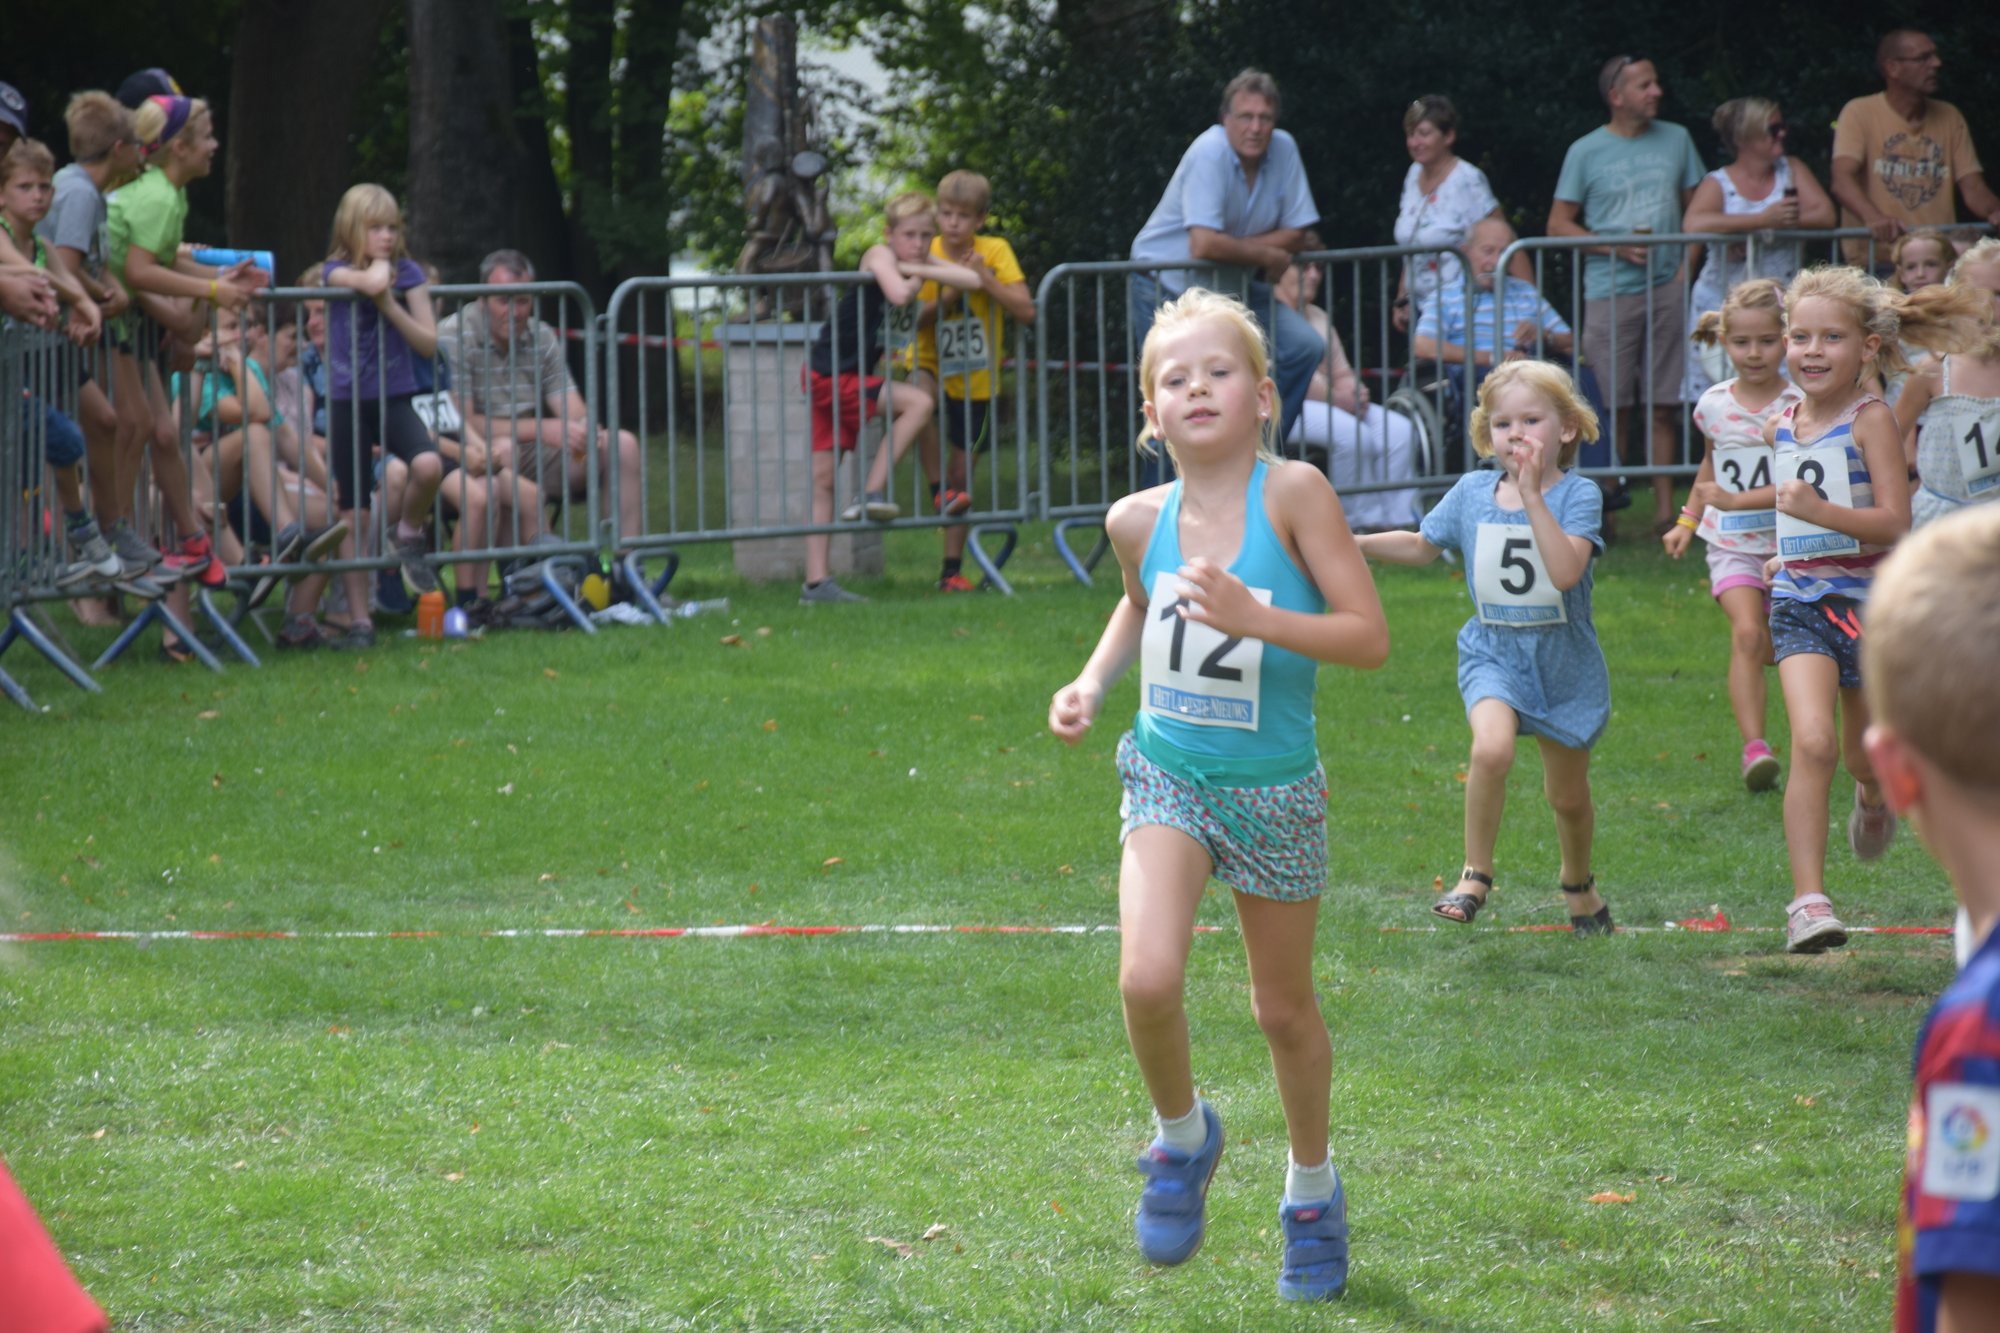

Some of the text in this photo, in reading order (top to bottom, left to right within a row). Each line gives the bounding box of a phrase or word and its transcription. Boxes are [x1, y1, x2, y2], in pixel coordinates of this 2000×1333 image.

[942, 323, 984, 358] 255
[1963, 421, 2000, 469] 1
[1722, 455, 1772, 492] 34
[1500, 538, 1536, 596] 5
[1160, 593, 1243, 682] 12
